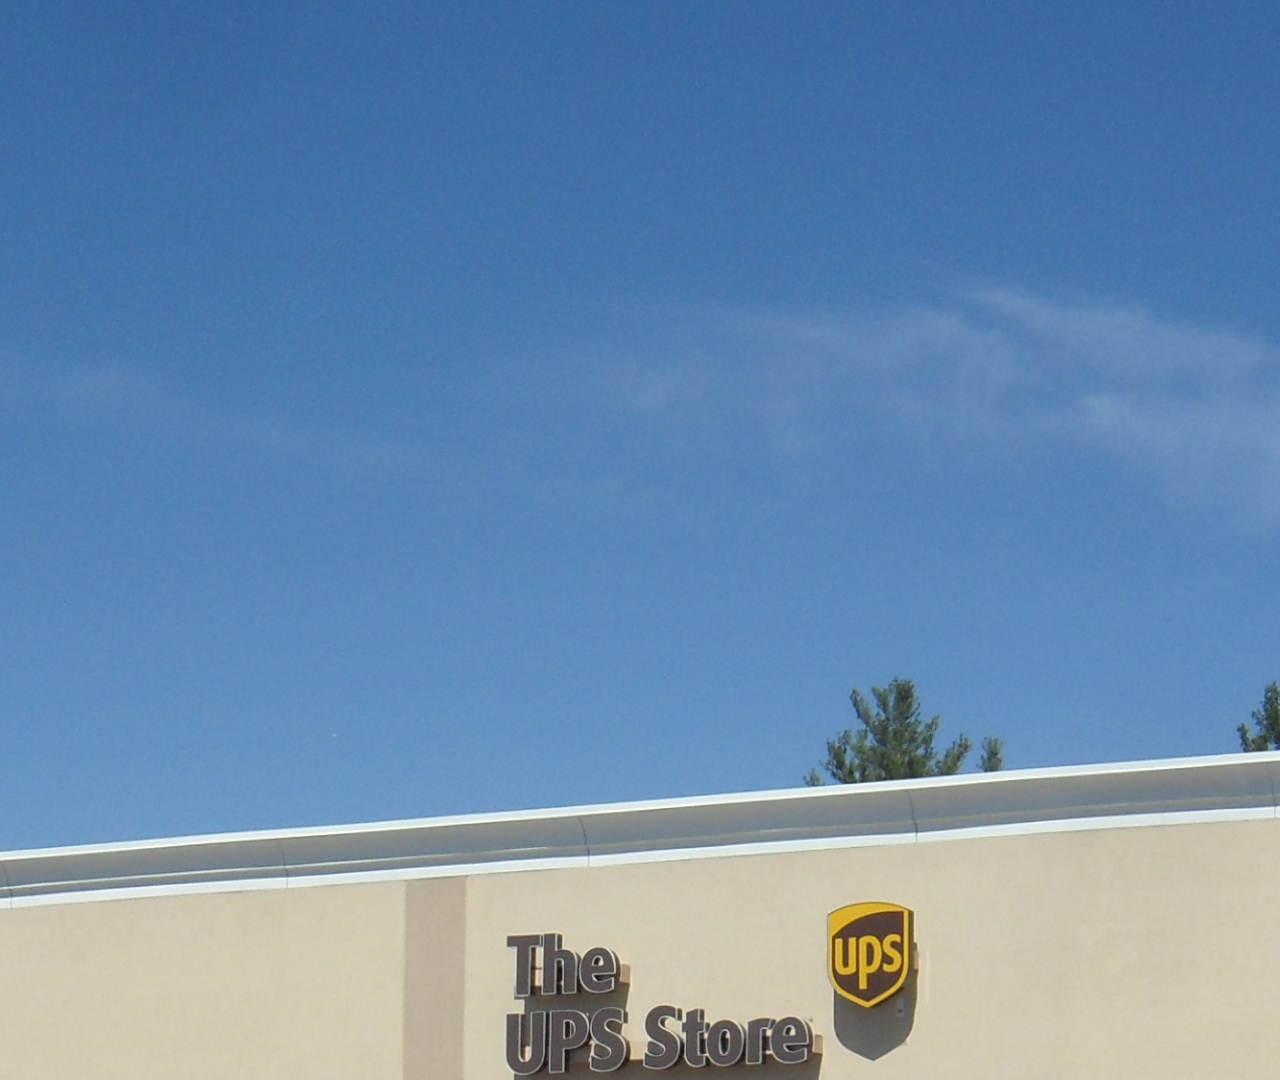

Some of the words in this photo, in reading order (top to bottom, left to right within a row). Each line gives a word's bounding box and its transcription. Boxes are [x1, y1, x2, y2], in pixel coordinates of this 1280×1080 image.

[506, 933, 619, 998] The
[834, 934, 902, 990] ups
[506, 1007, 627, 1075] UPS
[643, 1004, 811, 1071] Store
